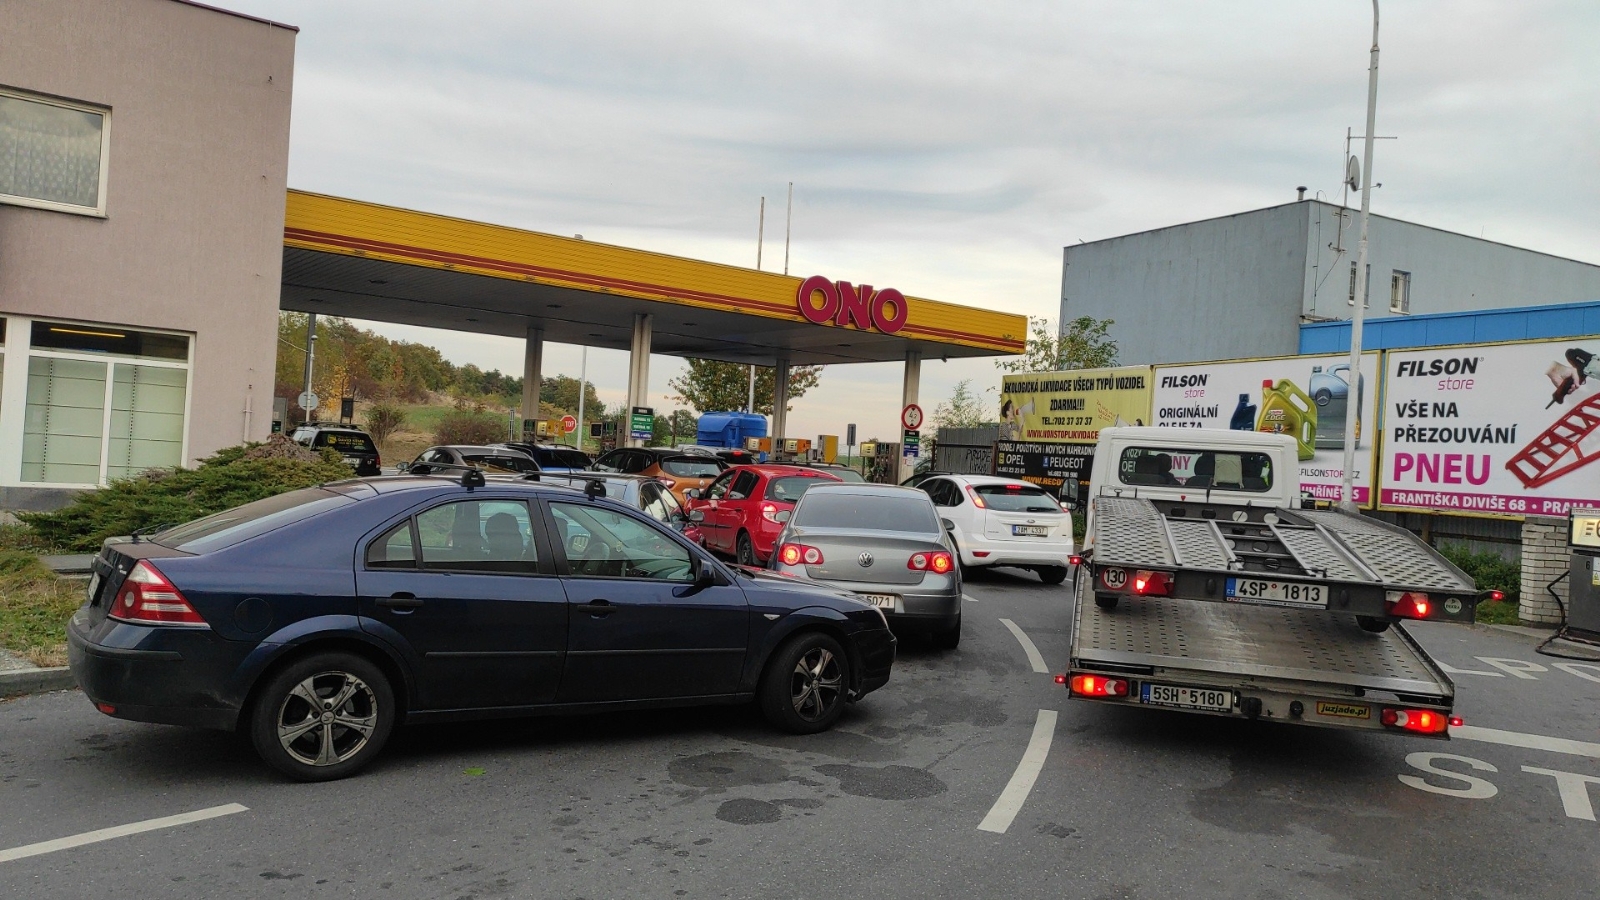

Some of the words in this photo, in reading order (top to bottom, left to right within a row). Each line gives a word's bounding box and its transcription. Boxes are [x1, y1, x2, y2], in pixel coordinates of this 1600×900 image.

[796, 275, 908, 334] ONO
[1396, 357, 1478, 377] FILSON
[1004, 378, 1039, 393] EKOLOGICKÁ
[1040, 379, 1072, 392] LIKVIDACE
[1073, 376, 1094, 391] VŠECH
[1096, 373, 1114, 390] TYPŮ
[1115, 376, 1145, 390] VOZIDEL
[1161, 374, 1207, 388] FILSON
[1437, 376, 1474, 390] store
[1184, 388, 1205, 398] store
[1050, 398, 1085, 411] ZDARMA!!!
[1159, 404, 1219, 418] ORIGINÁLNÍ
[1395, 399, 1428, 418] VŠE
[1432, 402, 1459, 418] NA
[1067, 416, 1074, 425] 37
[1075, 416, 1084, 425] 37
[1085, 416, 1093, 425] 37
[1394, 423, 1518, 444] PŘEZOUVÁNÍ
[1006, 454, 1025, 465] OPEL
[1049, 457, 1084, 469] PEUGEOT
[1393, 452, 1491, 486] PNEU
[1392, 491, 1459, 507] FRANTIŠKA
[1462, 494, 1505, 510] DIVIŠE
[1508, 499, 1526, 511] 68
[1106, 570, 1126, 583] 130
[1239, 580, 1268, 597] 4SP
[1282, 584, 1321, 602] 1813
[1153, 687, 1179, 702] 5SH
[1190, 690, 1224, 706] 5180
[1321, 703, 1367, 716] juzjade.pl
